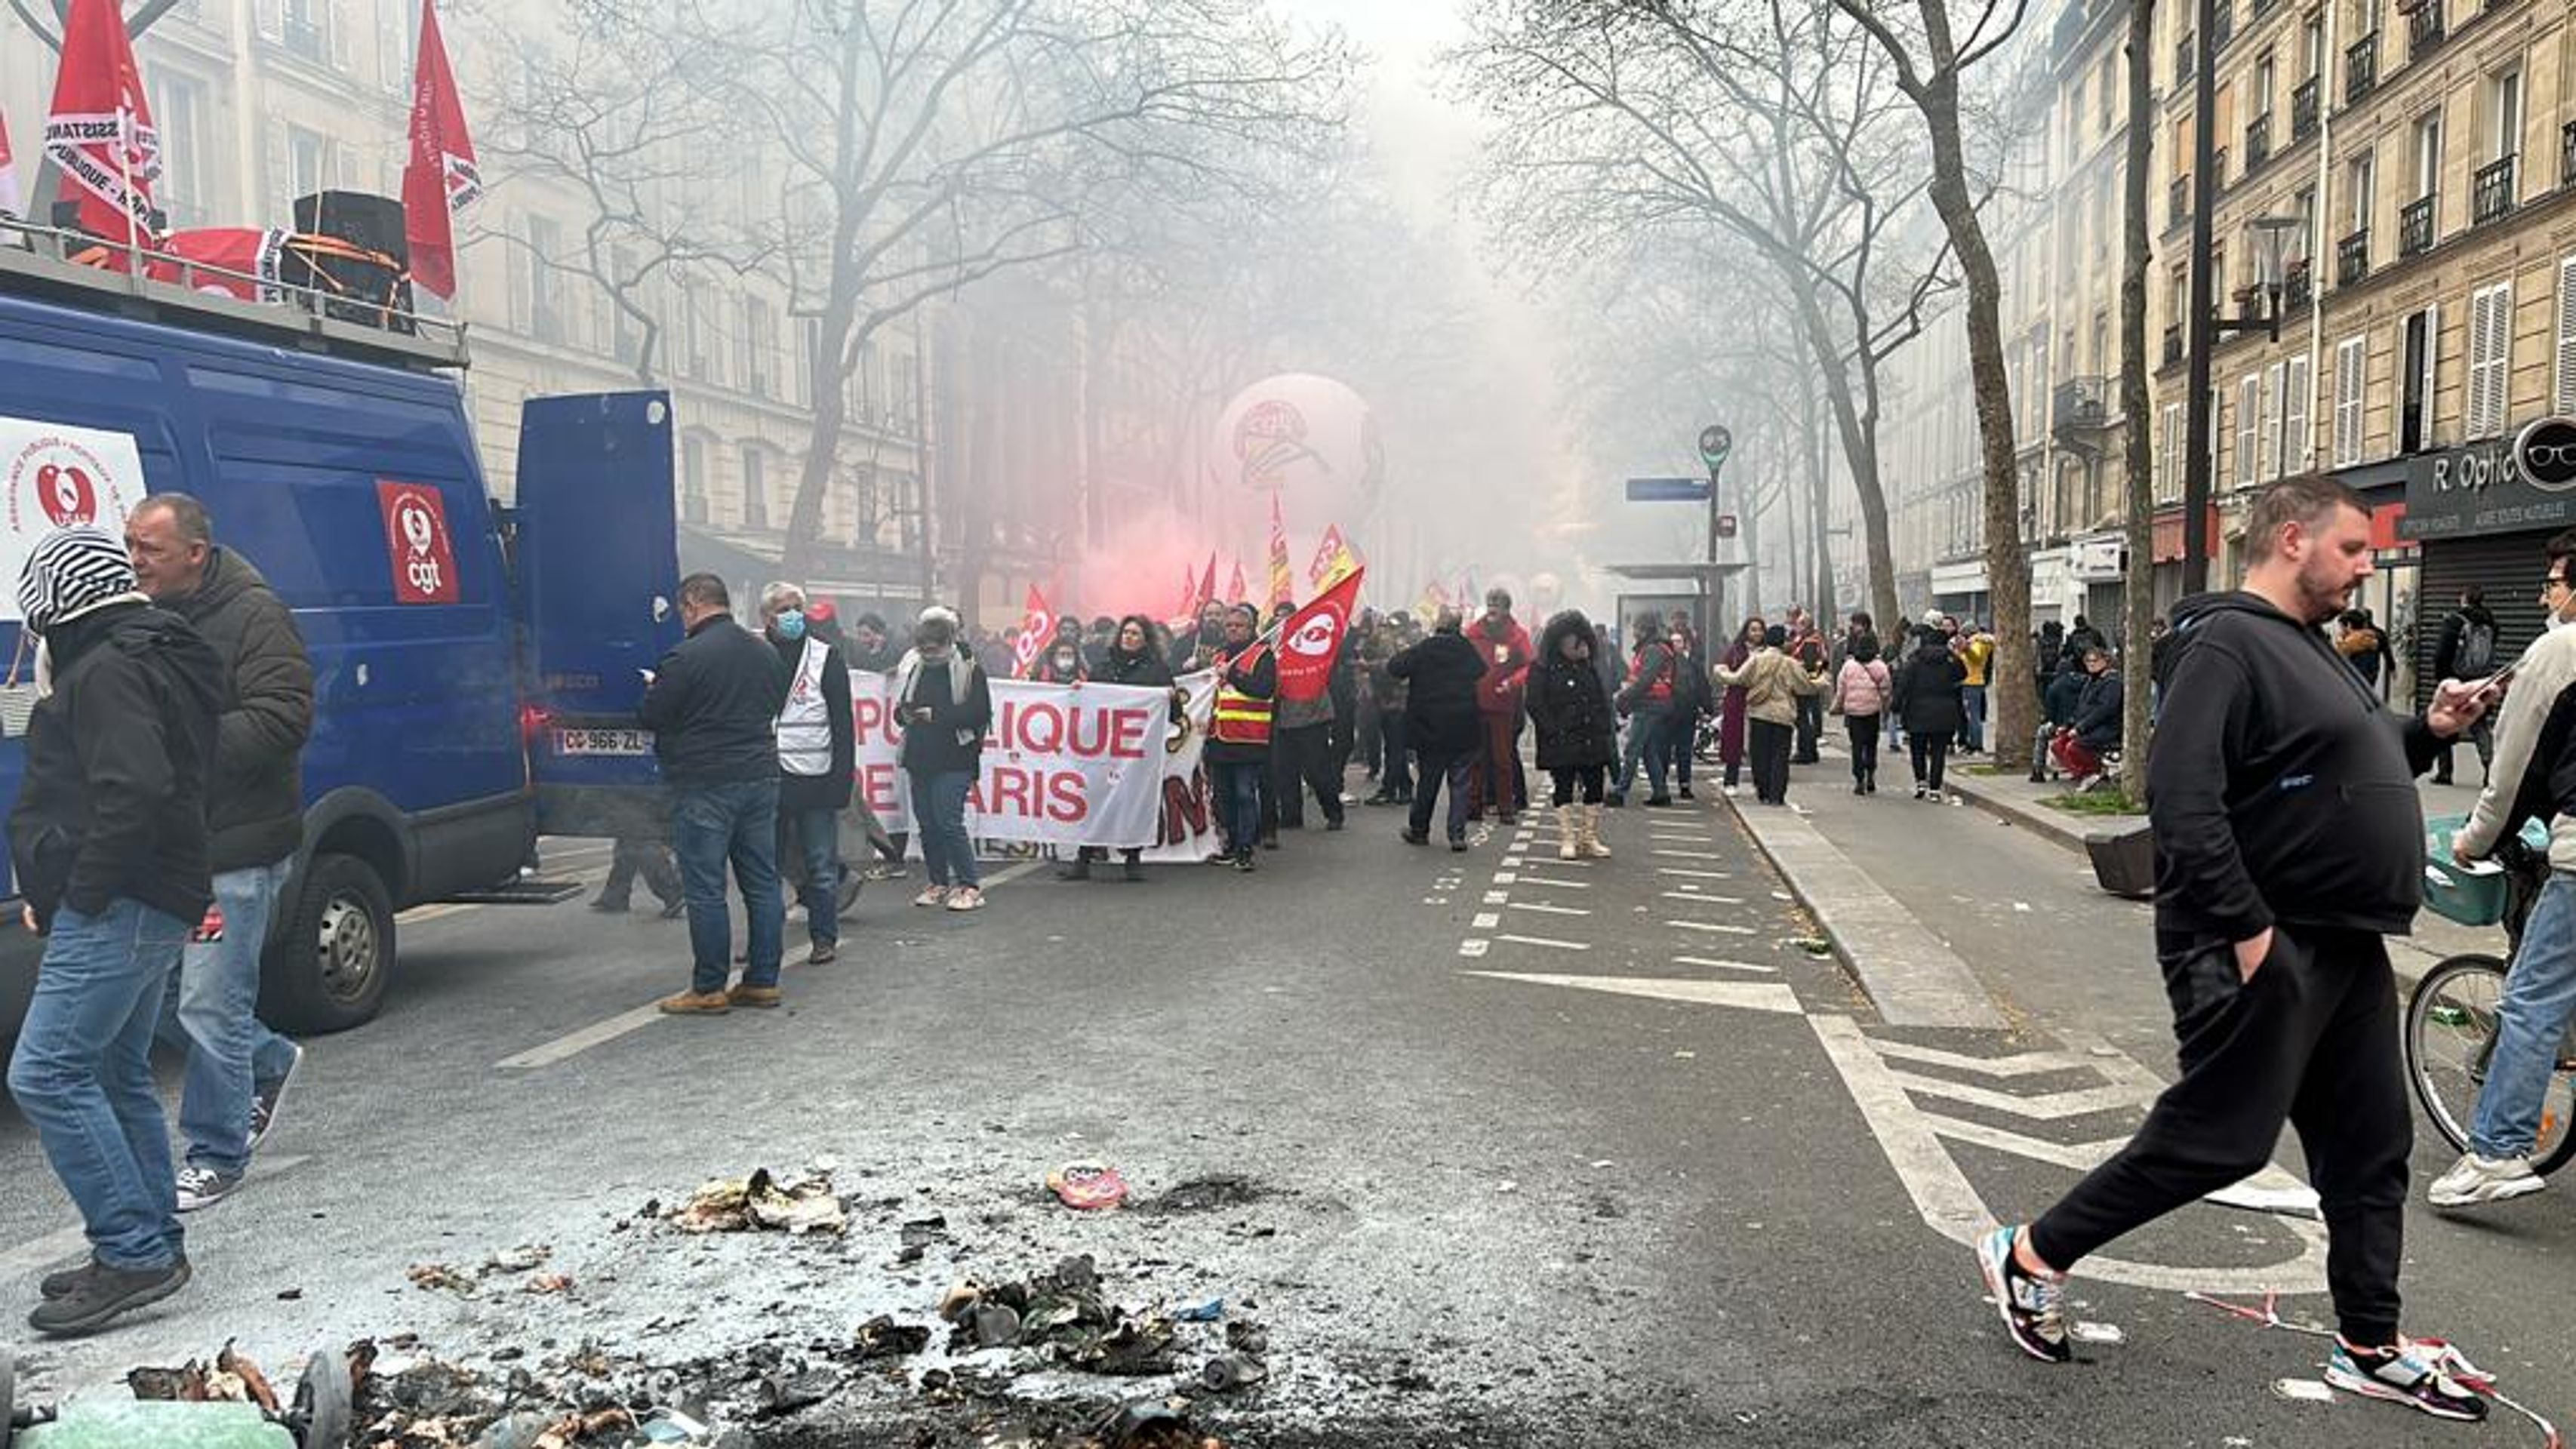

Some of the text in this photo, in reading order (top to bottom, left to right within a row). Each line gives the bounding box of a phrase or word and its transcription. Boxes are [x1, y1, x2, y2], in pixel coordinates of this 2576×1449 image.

[2433, 458, 2451, 493] R
[408, 555, 442, 595] cgt
[854, 697, 1149, 758] PUIQUE
[967, 766, 1088, 822] RIS
